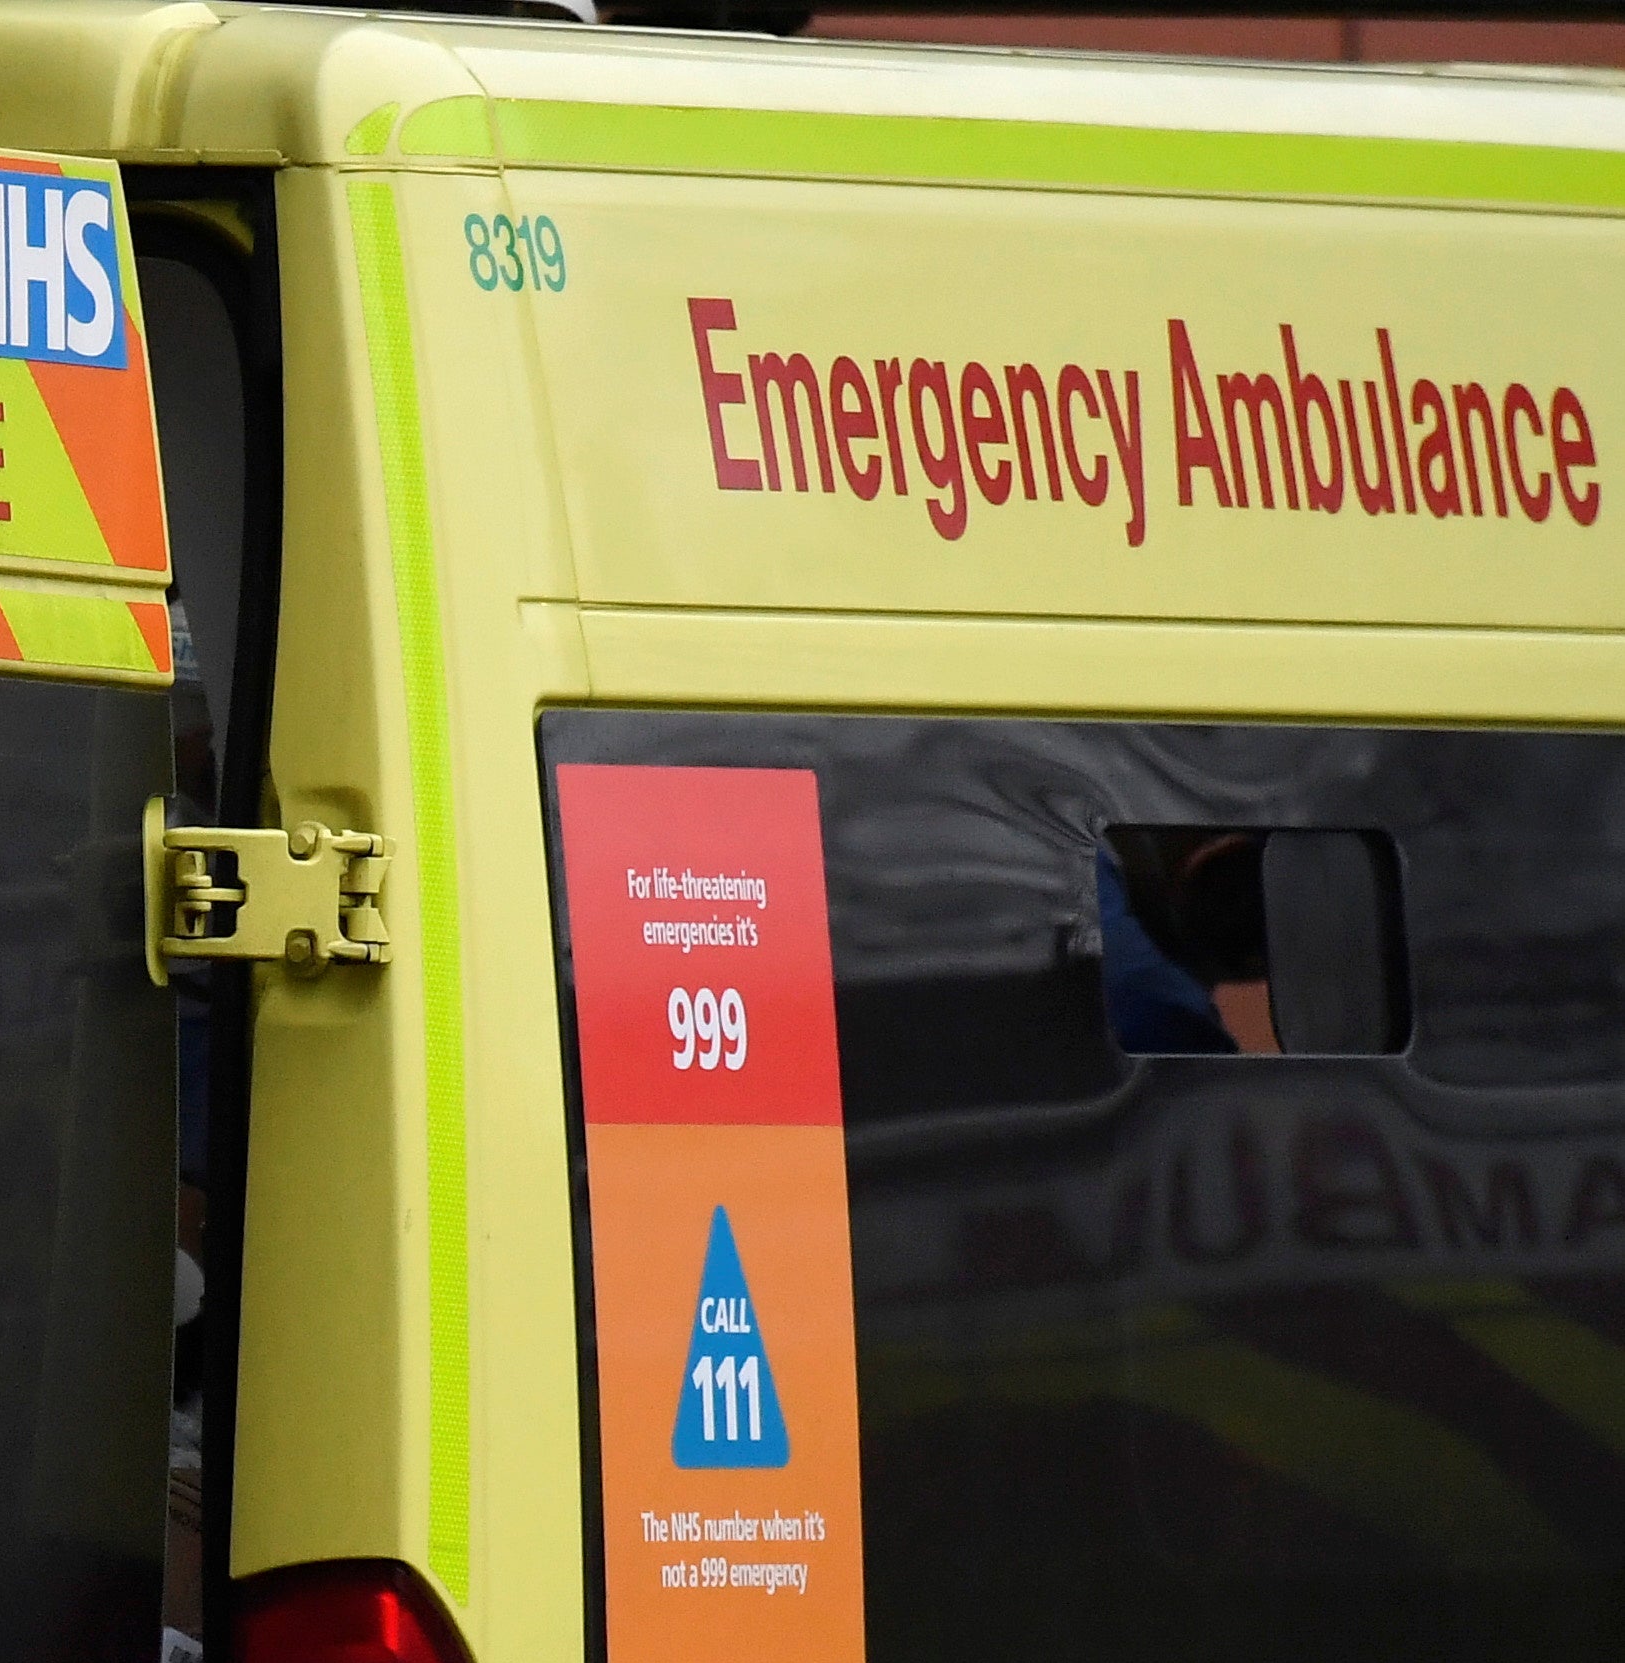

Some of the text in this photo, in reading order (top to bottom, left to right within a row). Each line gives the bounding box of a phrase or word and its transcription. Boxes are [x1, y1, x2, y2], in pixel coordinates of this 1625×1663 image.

[463, 212, 567, 294] 8319
[687, 296, 1601, 547] Emergency Ambulance
[626, 866, 767, 910] For life-threatening
[643, 914, 758, 953] emergencies it's
[667, 987, 748, 1071] 999
[700, 1296, 751, 1334] CALL
[691, 1355, 762, 1442] 111
[640, 1509, 826, 1543] The NHS number when it's
[661, 1556, 808, 1596] not a 999 emergency
